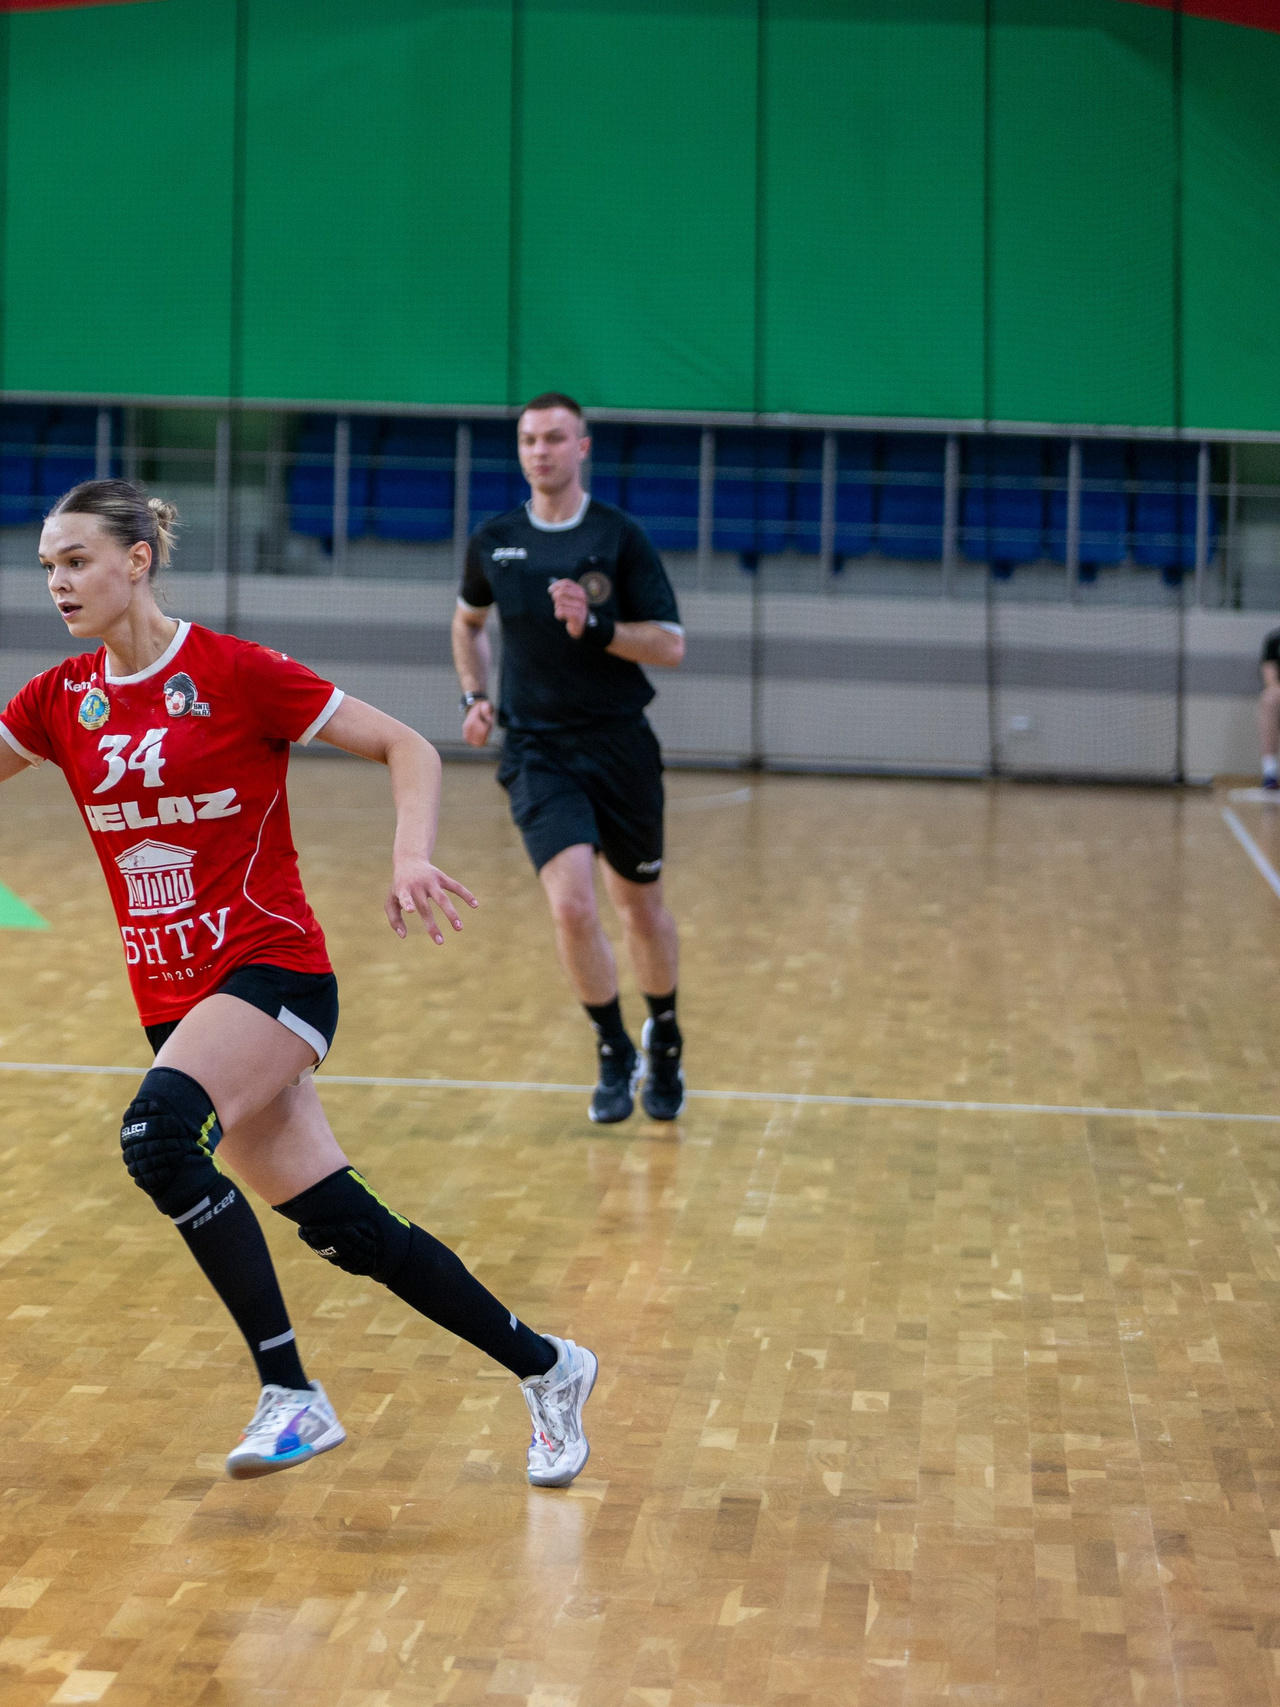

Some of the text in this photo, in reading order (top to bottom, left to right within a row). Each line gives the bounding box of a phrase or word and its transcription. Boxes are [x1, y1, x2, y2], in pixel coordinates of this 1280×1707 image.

[63, 672, 97, 692] Kema
[92, 727, 169, 794] 34
[121, 906, 231, 965] БНТУ
